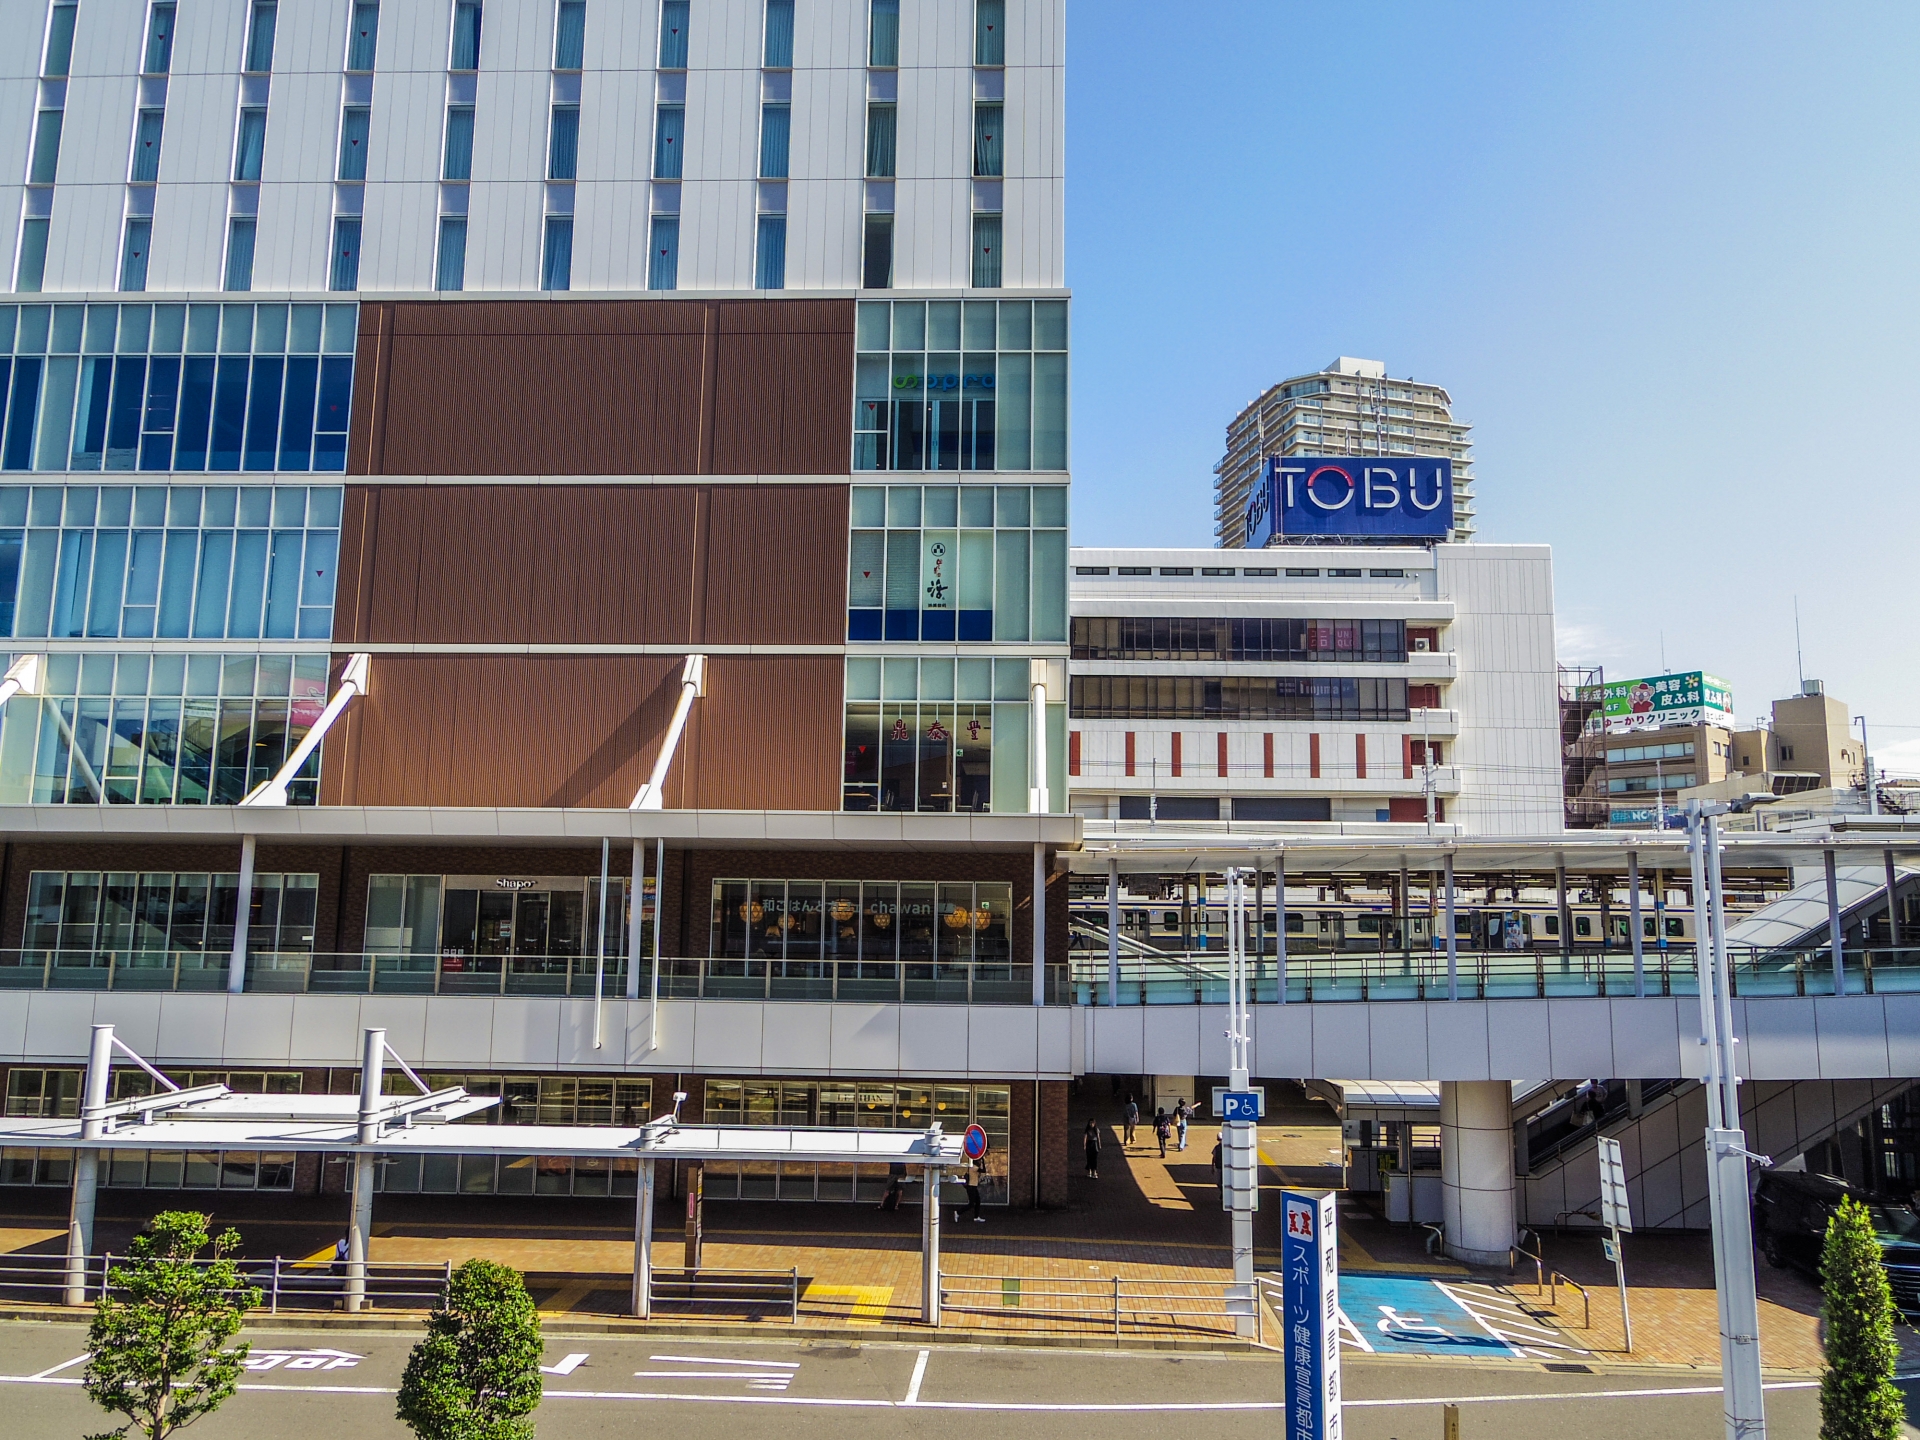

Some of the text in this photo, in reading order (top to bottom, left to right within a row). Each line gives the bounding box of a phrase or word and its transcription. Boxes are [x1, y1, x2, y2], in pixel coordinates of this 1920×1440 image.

[1274, 465, 1443, 510] TOBU
[1655, 679, 1681, 693] 美容
[1661, 691, 1700, 706] 皮ふ科
[496, 878, 536, 890] Shapo
[870, 900, 931, 914] chawan
[1225, 1098, 1239, 1116] P
